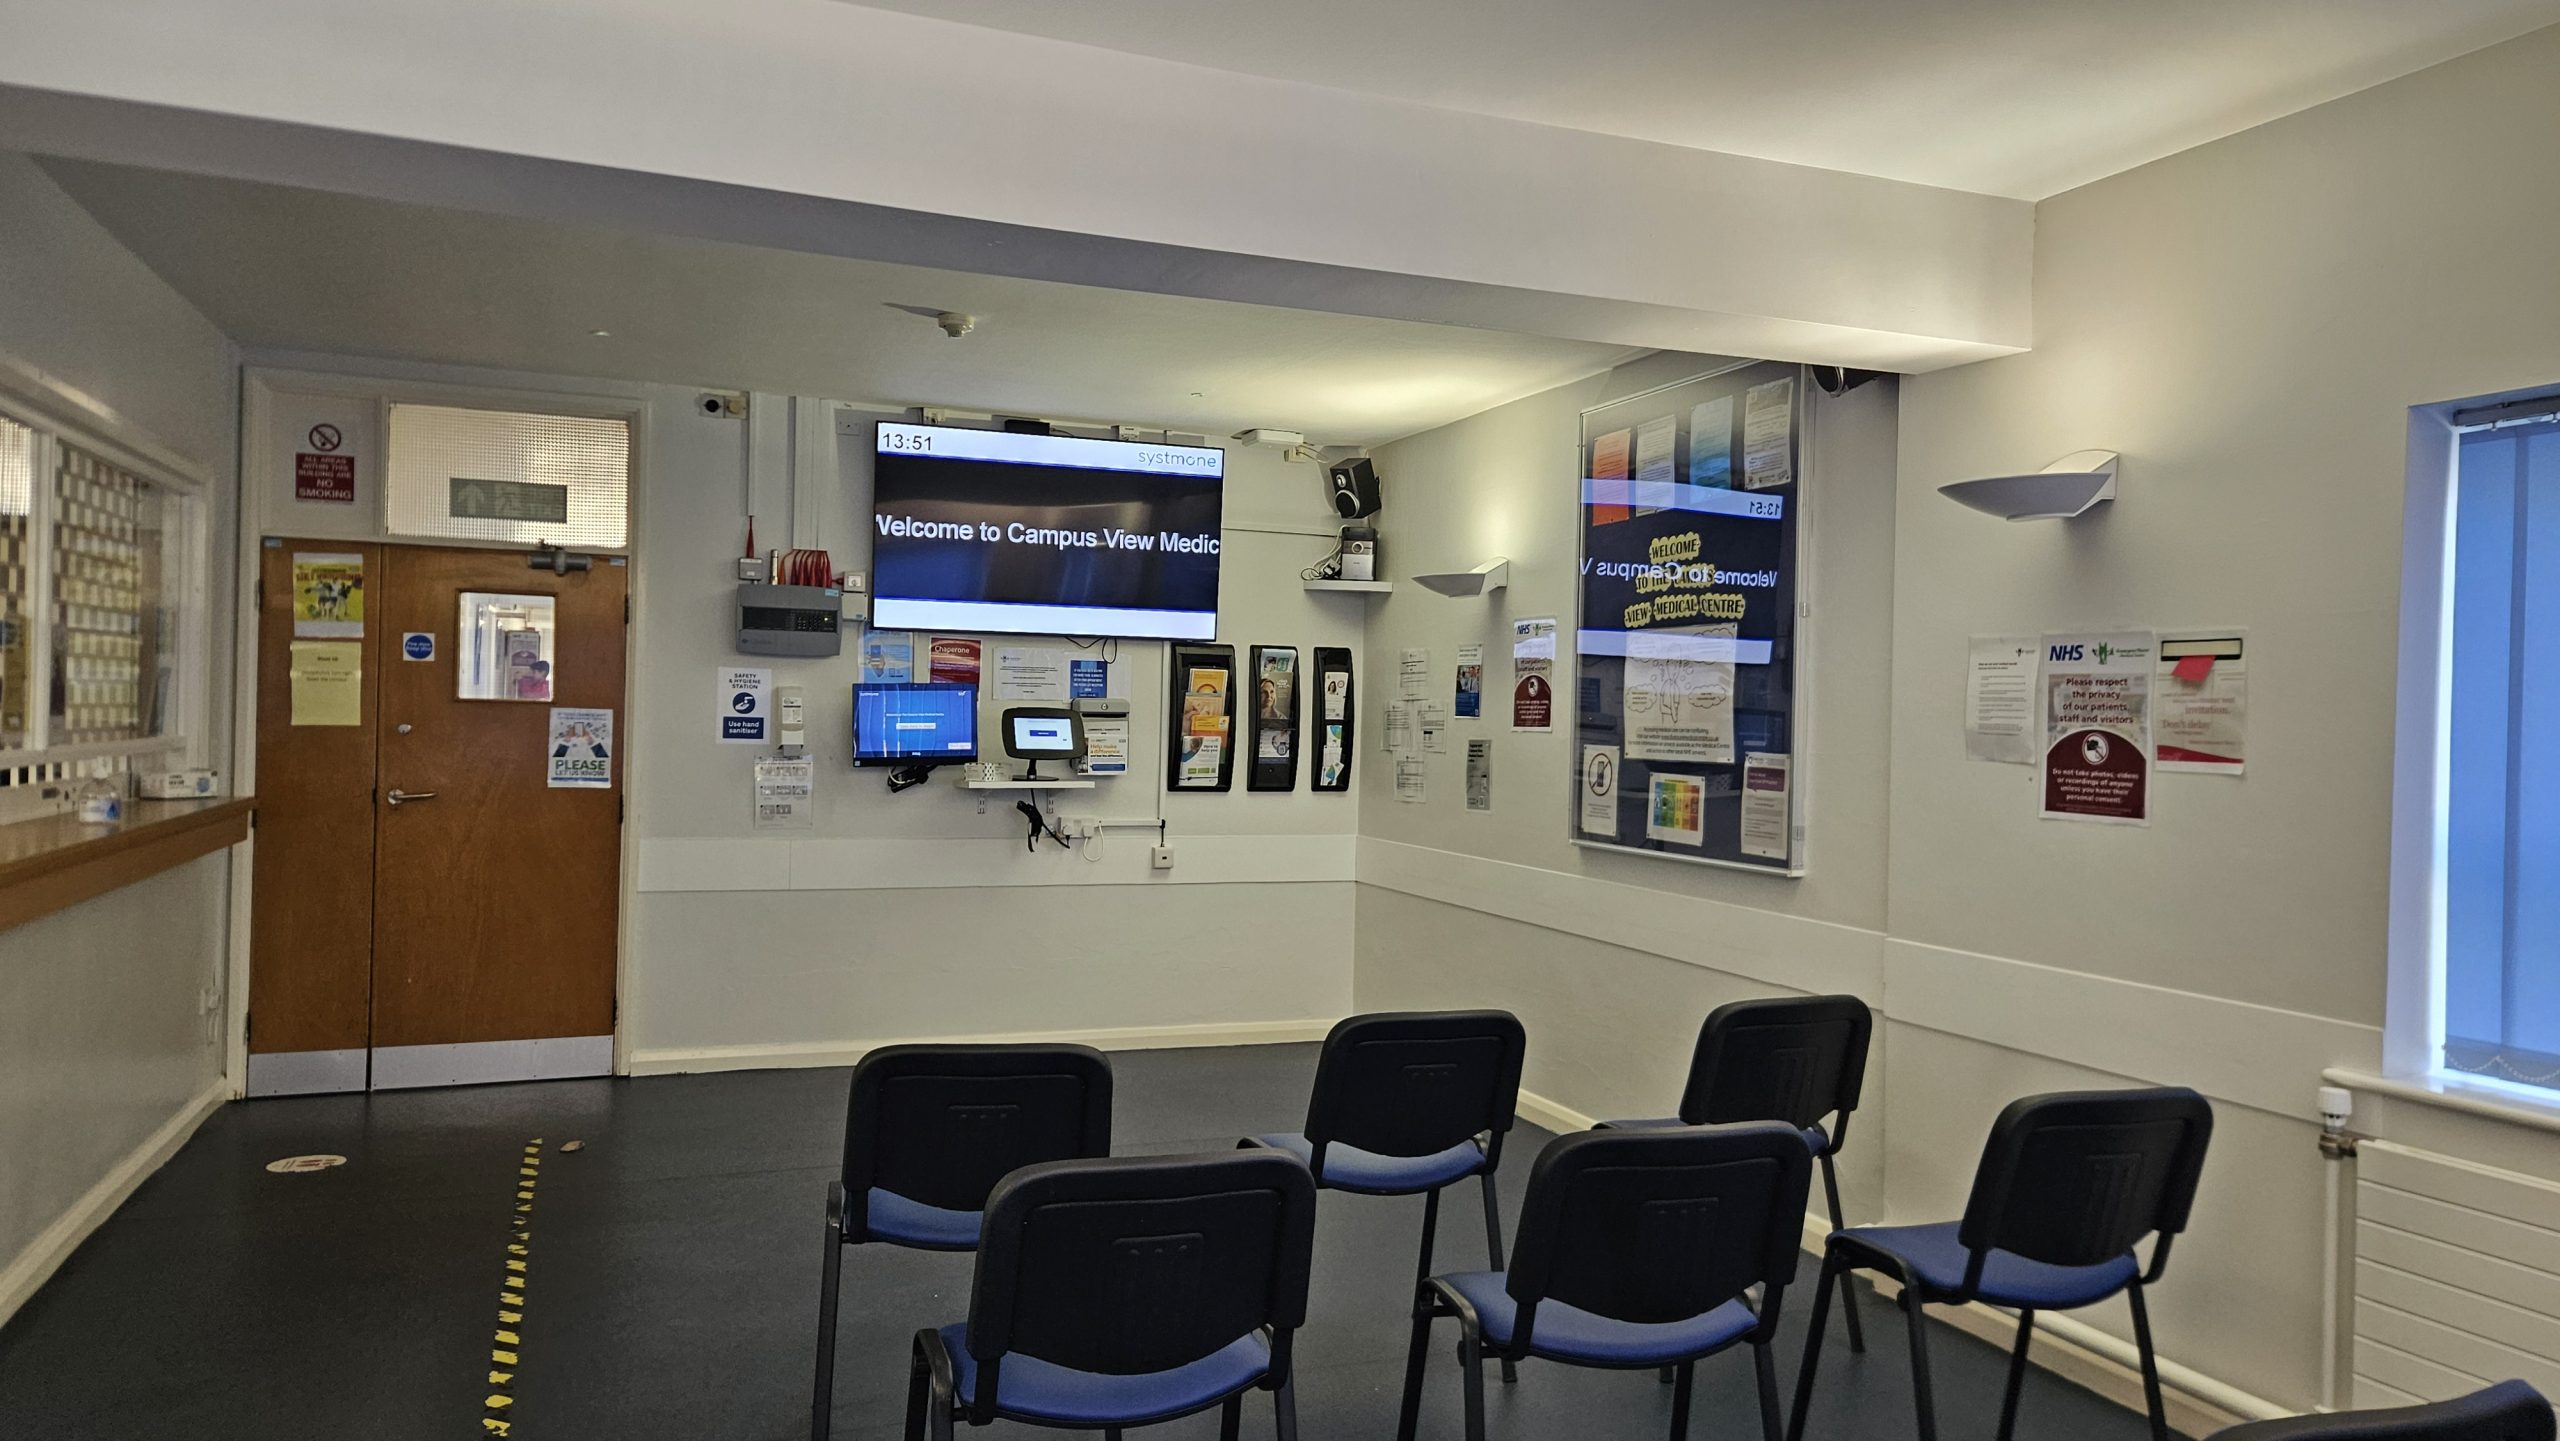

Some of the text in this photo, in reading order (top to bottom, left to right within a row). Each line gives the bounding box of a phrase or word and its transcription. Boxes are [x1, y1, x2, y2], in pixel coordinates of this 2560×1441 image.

[882, 433, 932, 451] 13:51
[1138, 451, 1217, 468] systmone
[316, 479, 333, 488] NO
[298, 488, 352, 499] SMOKING
[979, 522, 1001, 542] to
[1007, 522, 1097, 551] Campus
[1102, 528, 1155, 550] View
[1652, 538, 1698, 559] WELCOME
[1627, 599, 1742, 625] VIEW MEDICAL CENTRE
[1516, 624, 1531, 635] NHS
[934, 645, 970, 654] Chaperone
[2049, 644, 2084, 662] NHS
[2066, 678, 2128, 687] Please respect
[2072, 690, 2120, 700] the privacy
[2062, 702, 2072, 711] of
[2074, 703, 2089, 711] our
[2060, 714, 2134, 724] staff and visitors
[555, 760, 606, 771] PLEASE
[2065, 778, 2099, 786] recordings
